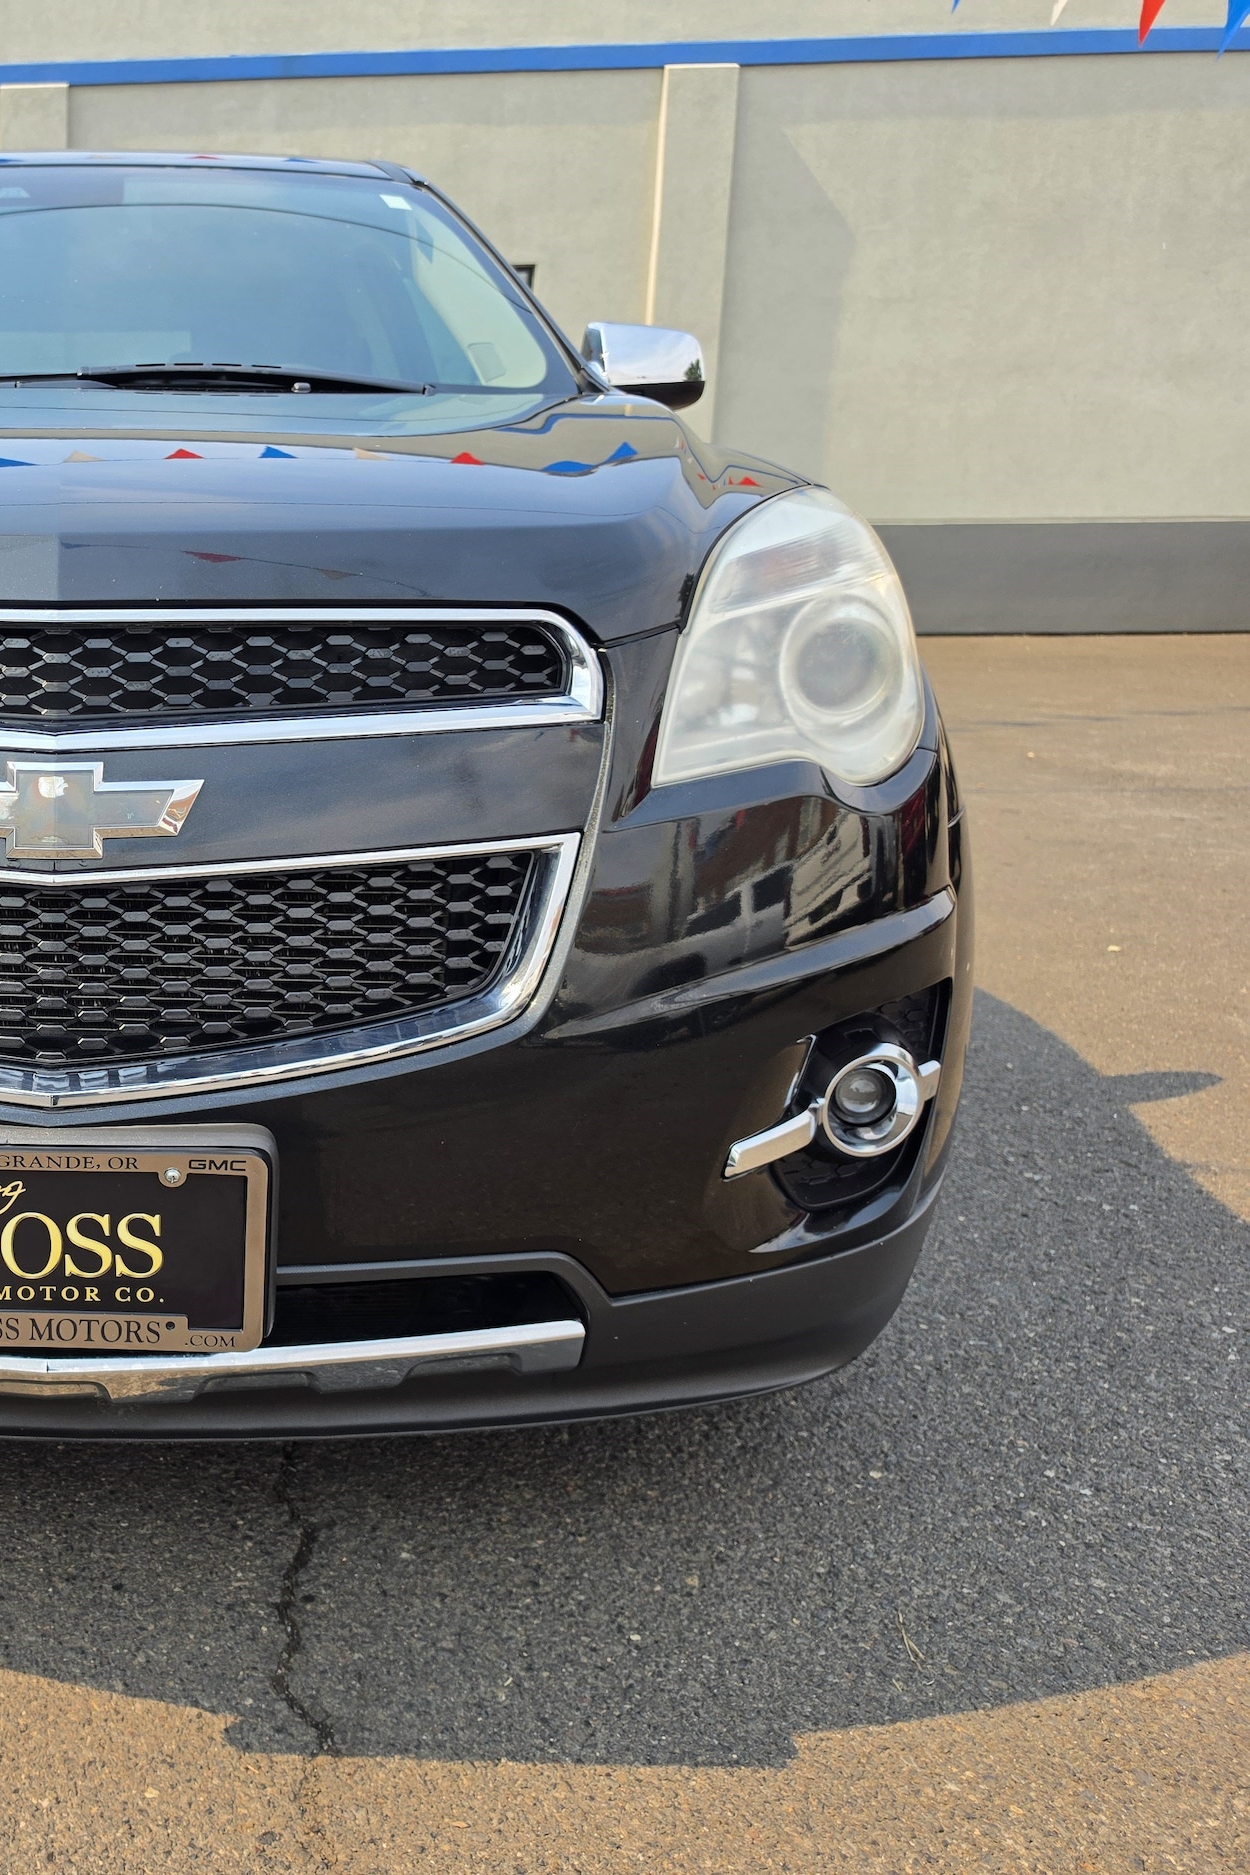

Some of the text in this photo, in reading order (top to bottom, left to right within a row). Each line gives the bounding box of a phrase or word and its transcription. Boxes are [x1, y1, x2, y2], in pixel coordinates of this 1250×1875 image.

[107, 1156, 140, 1171] OR
[188, 1159, 247, 1172] GMC
[114, 1286, 165, 1303] CO.
[28, 1317, 162, 1345] MOTORS
[184, 1334, 237, 1349] .COM
